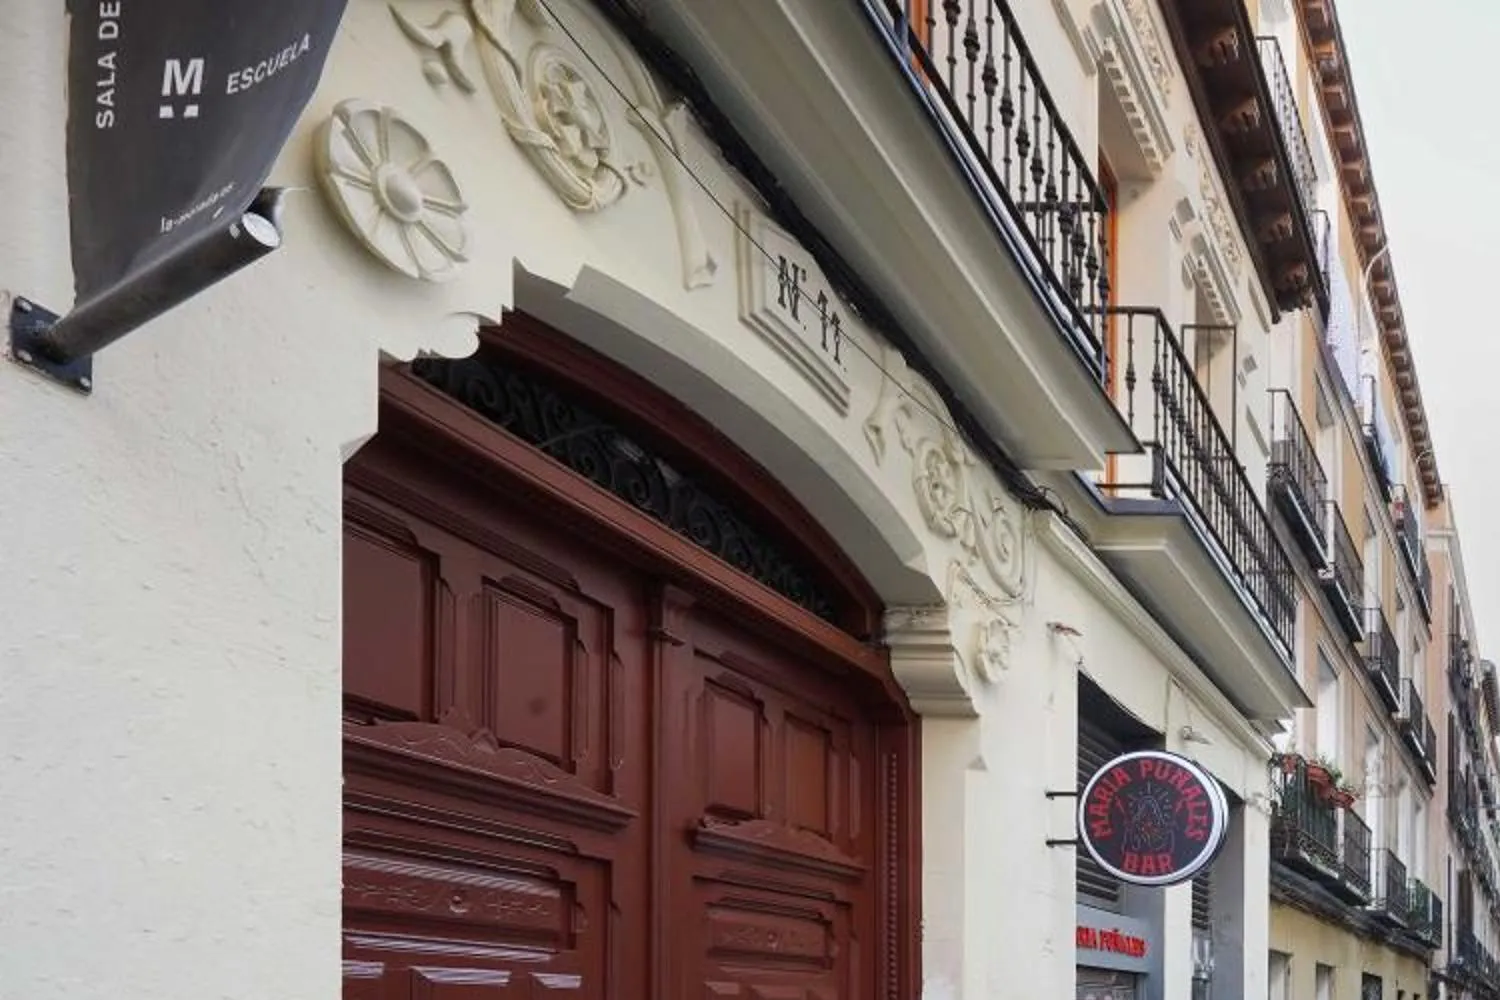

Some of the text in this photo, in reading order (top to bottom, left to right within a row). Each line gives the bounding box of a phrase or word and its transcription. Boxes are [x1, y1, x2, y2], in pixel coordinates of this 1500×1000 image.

[97, 1, 121, 128] SALA DE
[225, 33, 311, 96] ESCUELA
[1124, 853, 1174, 875] BAR
